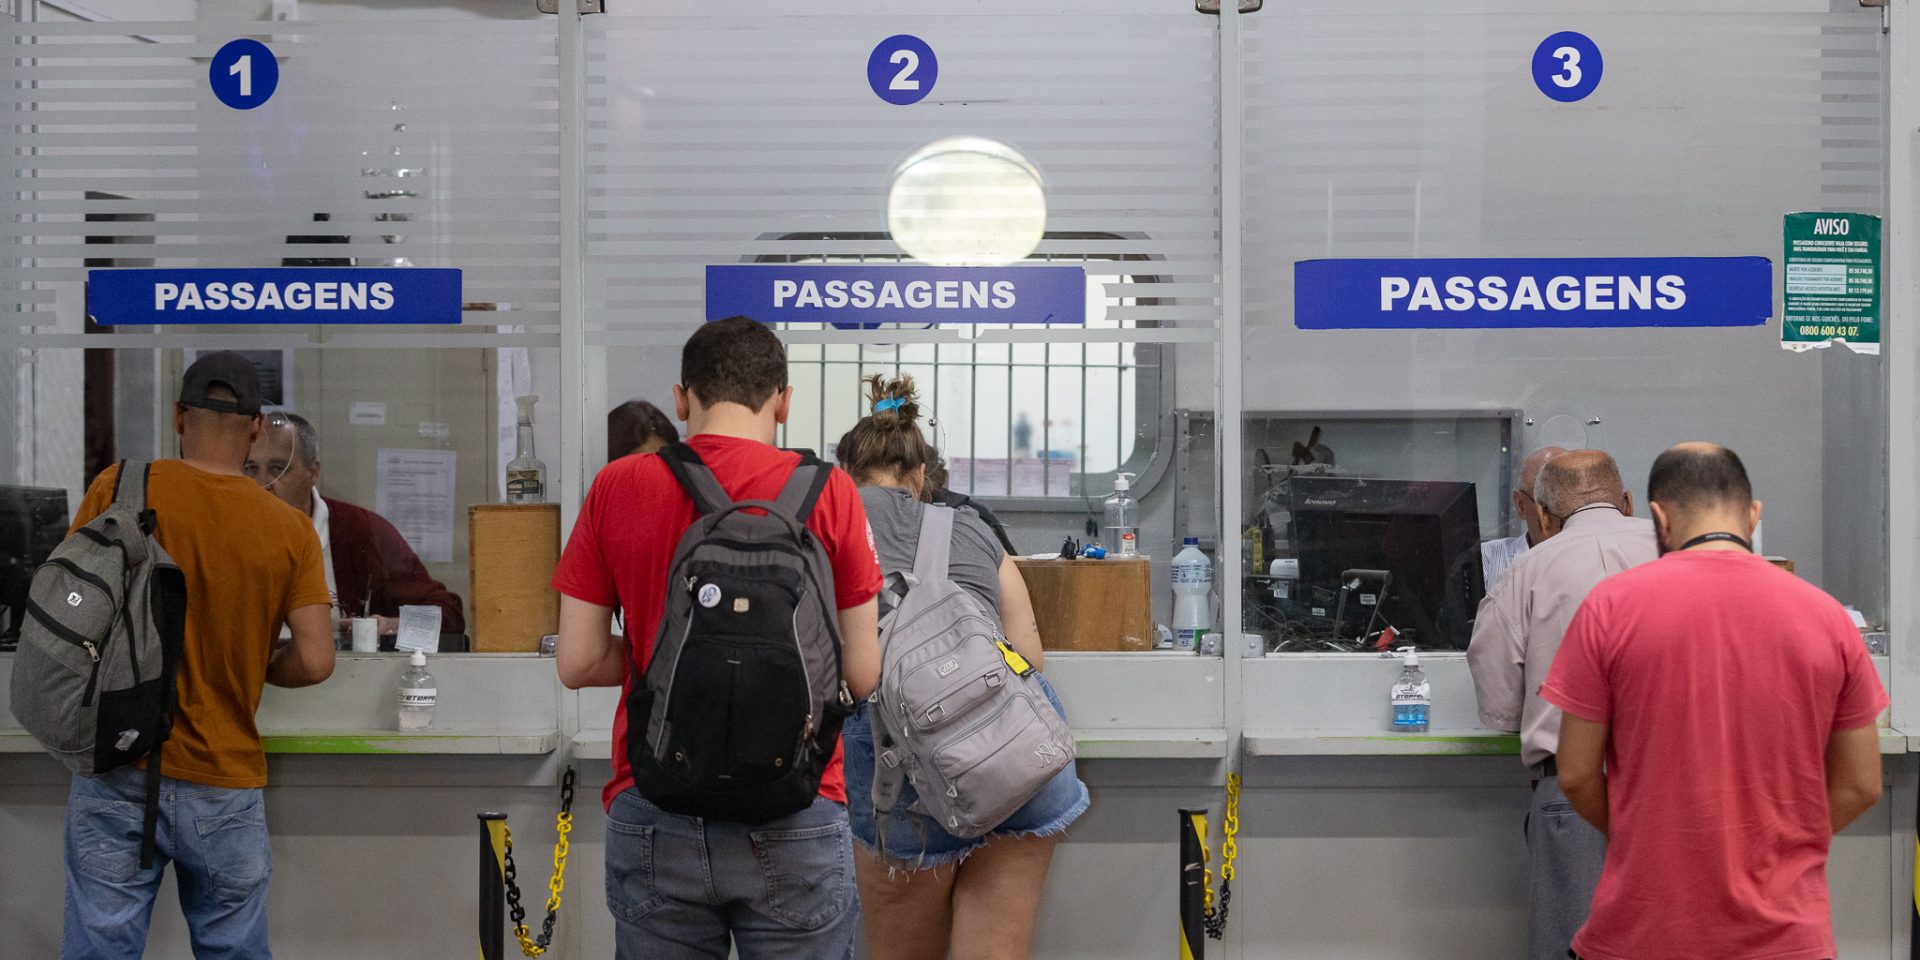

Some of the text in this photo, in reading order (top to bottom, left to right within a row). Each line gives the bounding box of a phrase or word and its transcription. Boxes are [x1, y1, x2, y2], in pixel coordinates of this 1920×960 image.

[229, 55, 252, 96] 1
[889, 50, 919, 90] 2
[1552, 47, 1582, 87] 3
[1814, 219, 1849, 235] AVISO
[155, 282, 395, 311] PASSAGENS
[773, 280, 1016, 309] PASSAGENS
[1380, 275, 1687, 311] PASSAGENS
[1800, 326, 1859, 337] 0800 600 43 07.
